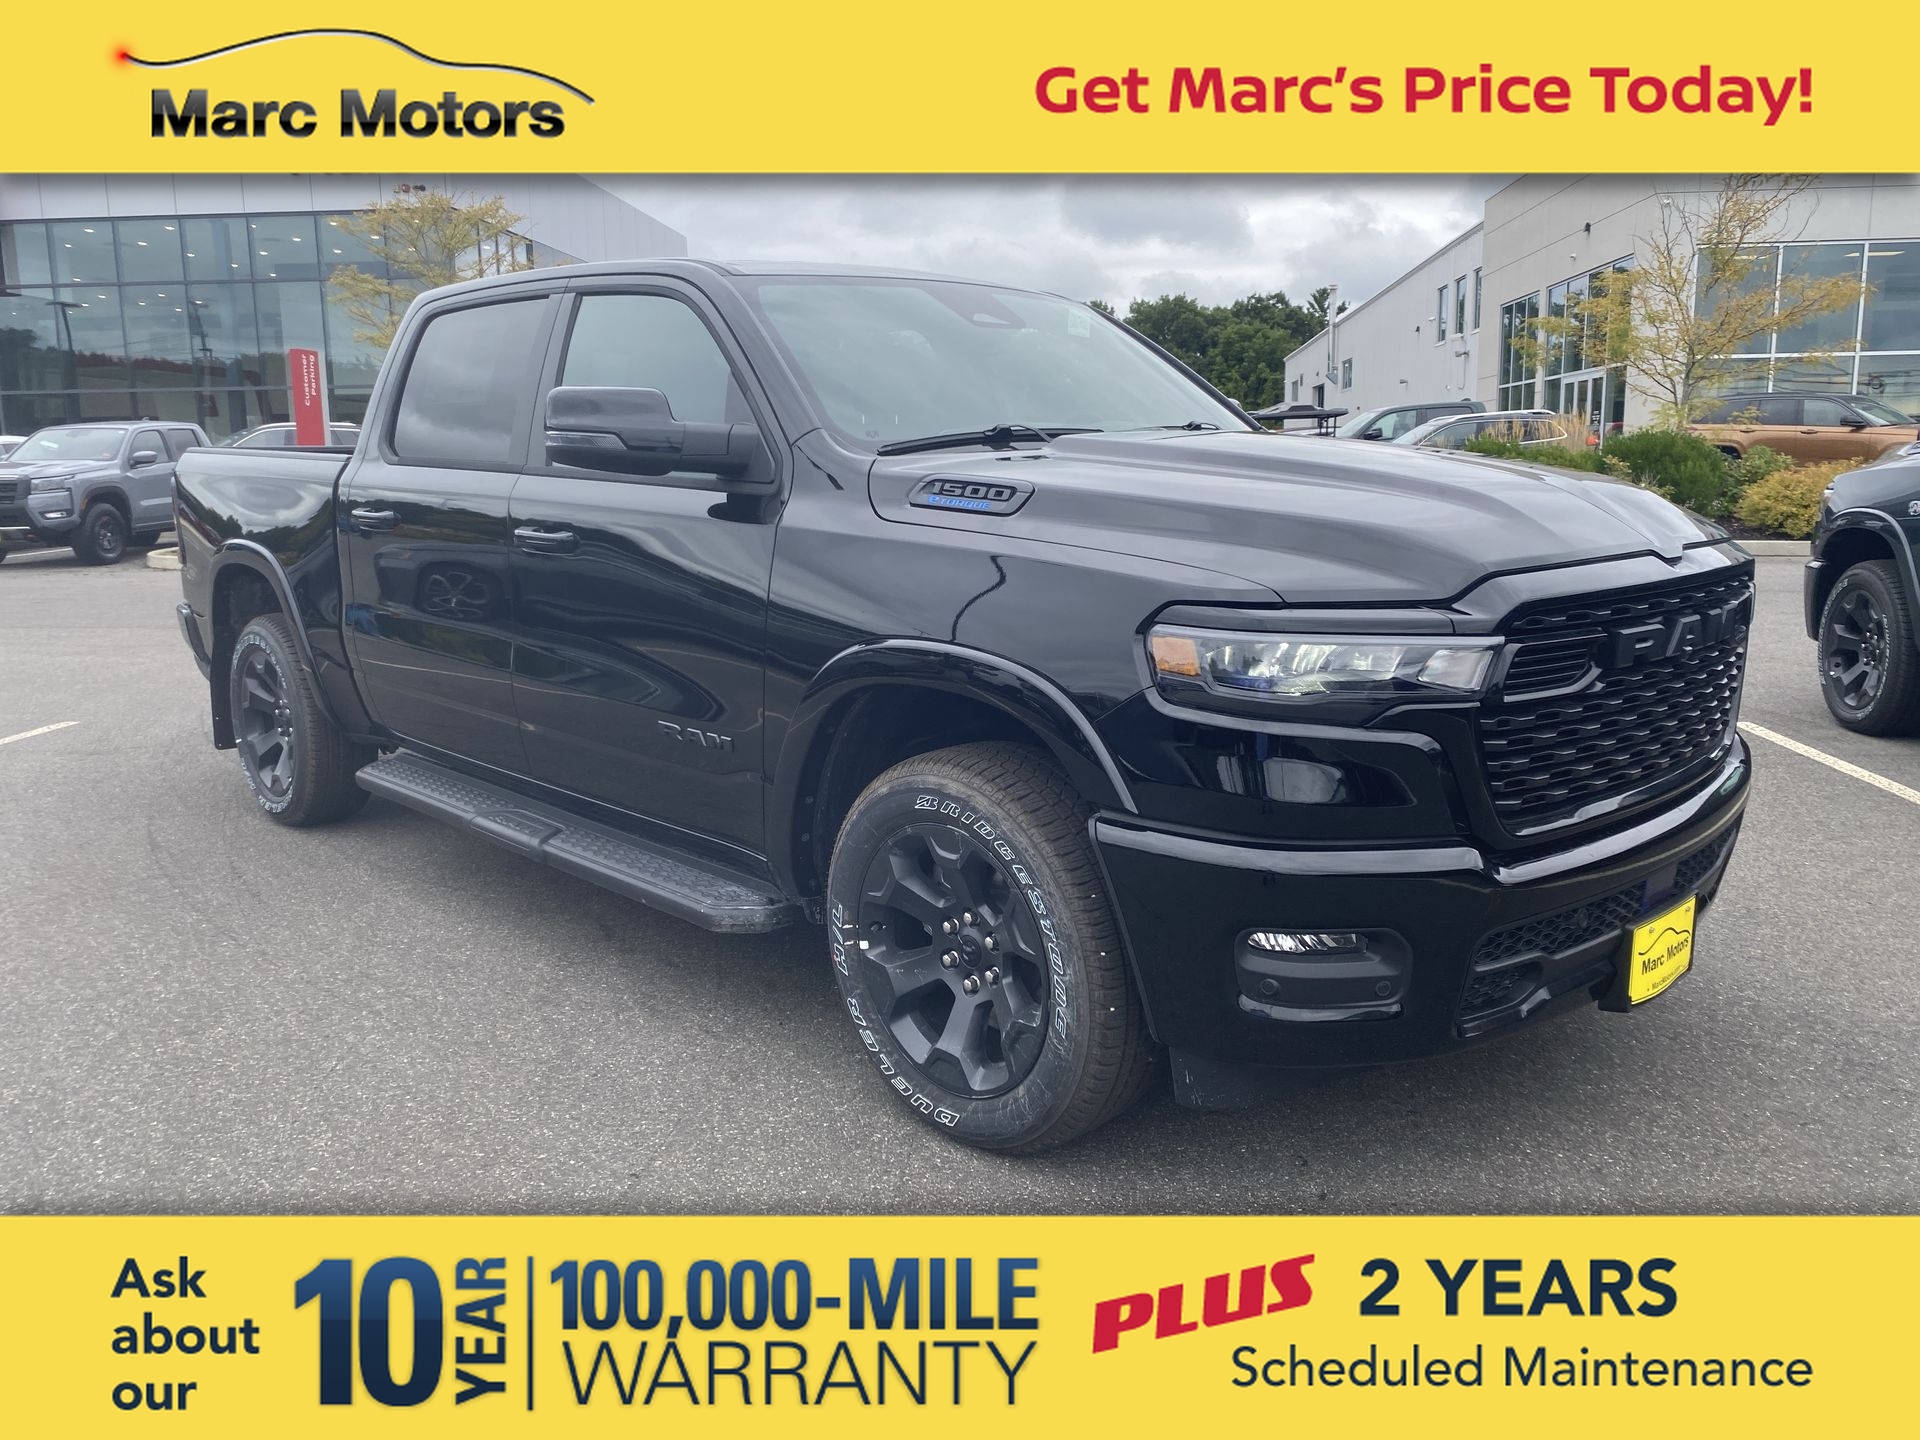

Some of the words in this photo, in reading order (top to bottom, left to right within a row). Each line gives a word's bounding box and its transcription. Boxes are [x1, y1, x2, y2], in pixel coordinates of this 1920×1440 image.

[302, 354, 310, 406] Customer
[929, 481, 1012, 500] 1500
[1613, 600, 1740, 669] RAM
[658, 720, 735, 753] RAM
[914, 795, 1068, 1040] BRIDGESTONE
[1641, 955, 1664, 975] Marc
[1667, 937, 1689, 961] Motors
[847, 997, 960, 1127] DUELER
